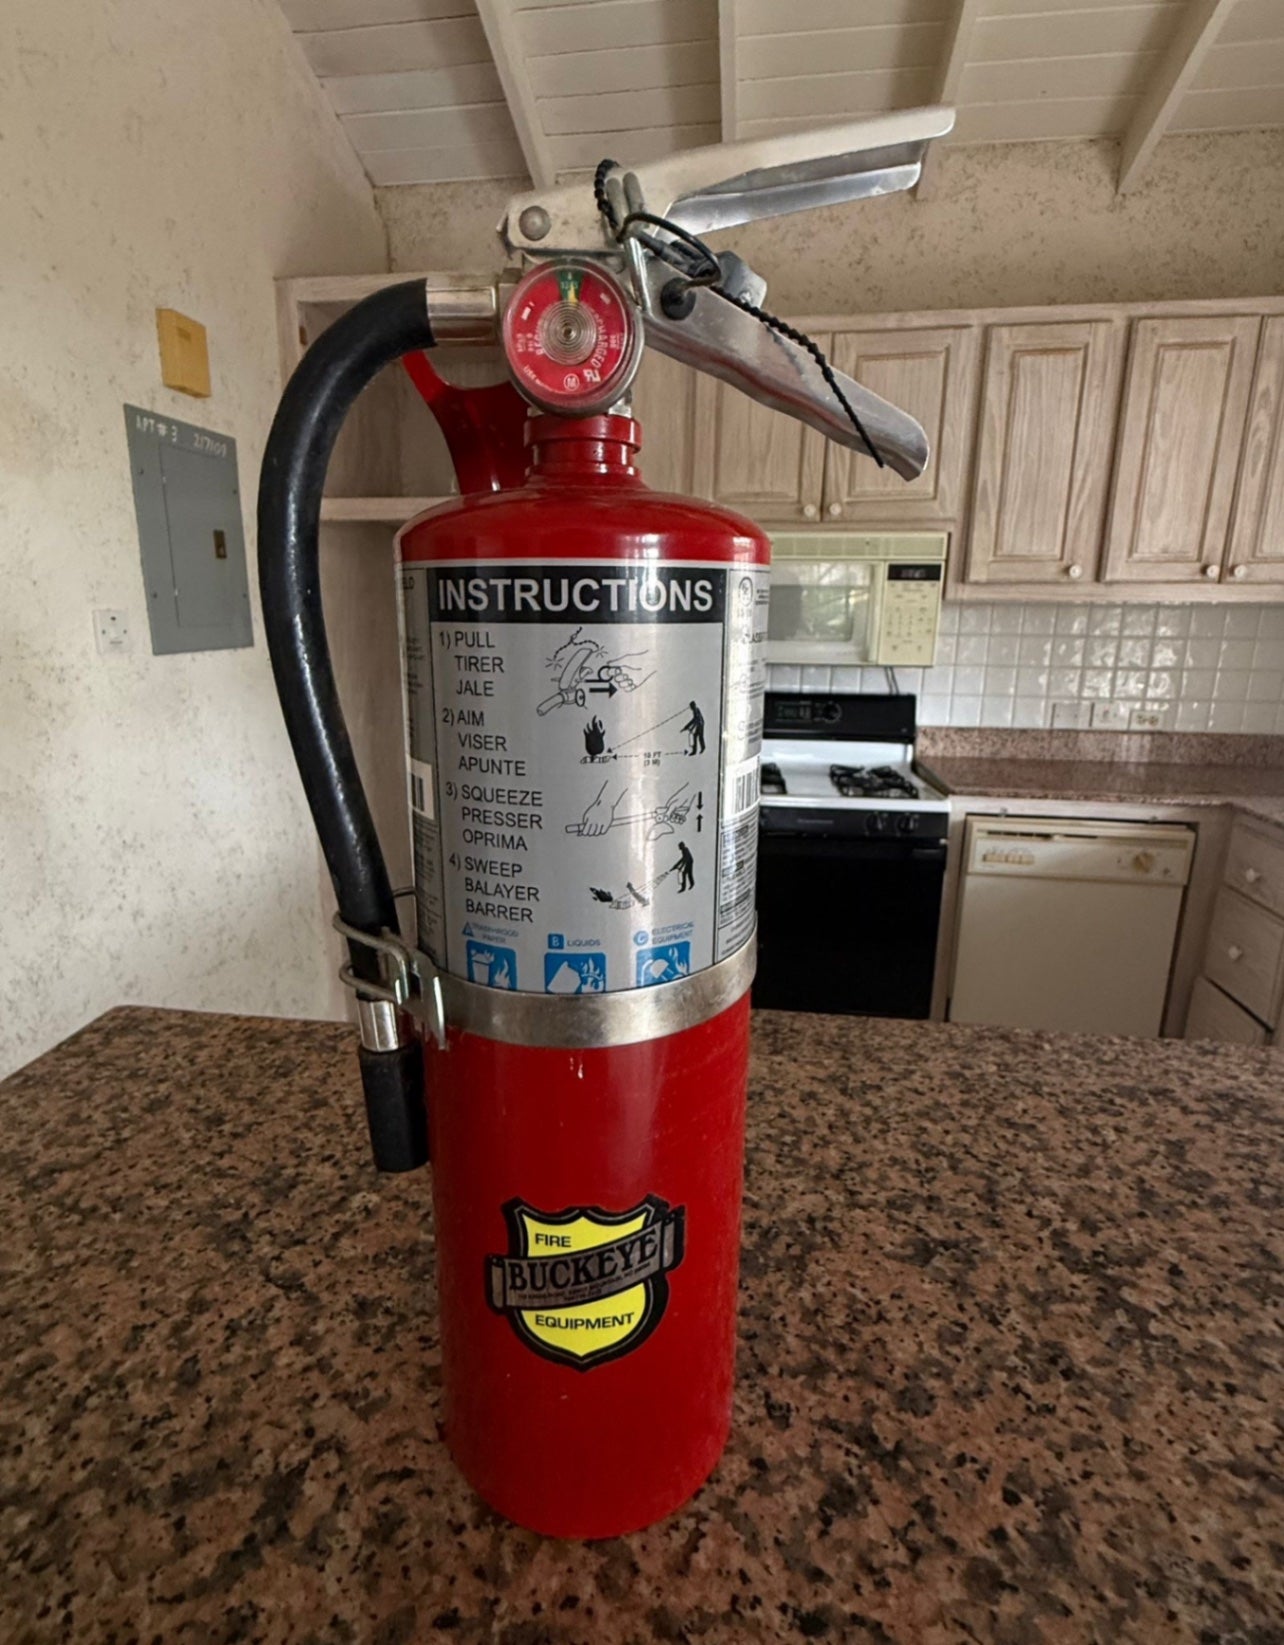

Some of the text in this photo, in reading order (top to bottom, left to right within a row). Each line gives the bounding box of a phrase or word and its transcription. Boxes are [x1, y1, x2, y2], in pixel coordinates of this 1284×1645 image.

[438, 577, 713, 613] INSTRUCTIONS
[439, 630, 496, 649] 1) PULL
[455, 655, 505, 673] TIRER
[456, 679, 495, 697] JALE
[442, 707, 485, 728] 2) AIM
[458, 732, 507, 751] VISER
[458, 756, 527, 776] APUNTE
[445, 782, 543, 807] 3) SQUEEZE
[461, 806, 544, 830] PRESSER
[462, 829, 528, 851] OPRIMA
[449, 856, 523, 878] 4) SWEEP
[464, 877, 540, 902] BALAYER
[465, 899, 534, 923] BARRER
[652, 930, 693, 945] EQUIPMENT
[535, 1233, 572, 1248] FIRE
[508, 1229, 659, 1291] BUCKEYE
[535, 1312, 635, 1330] EQUIPMENT
